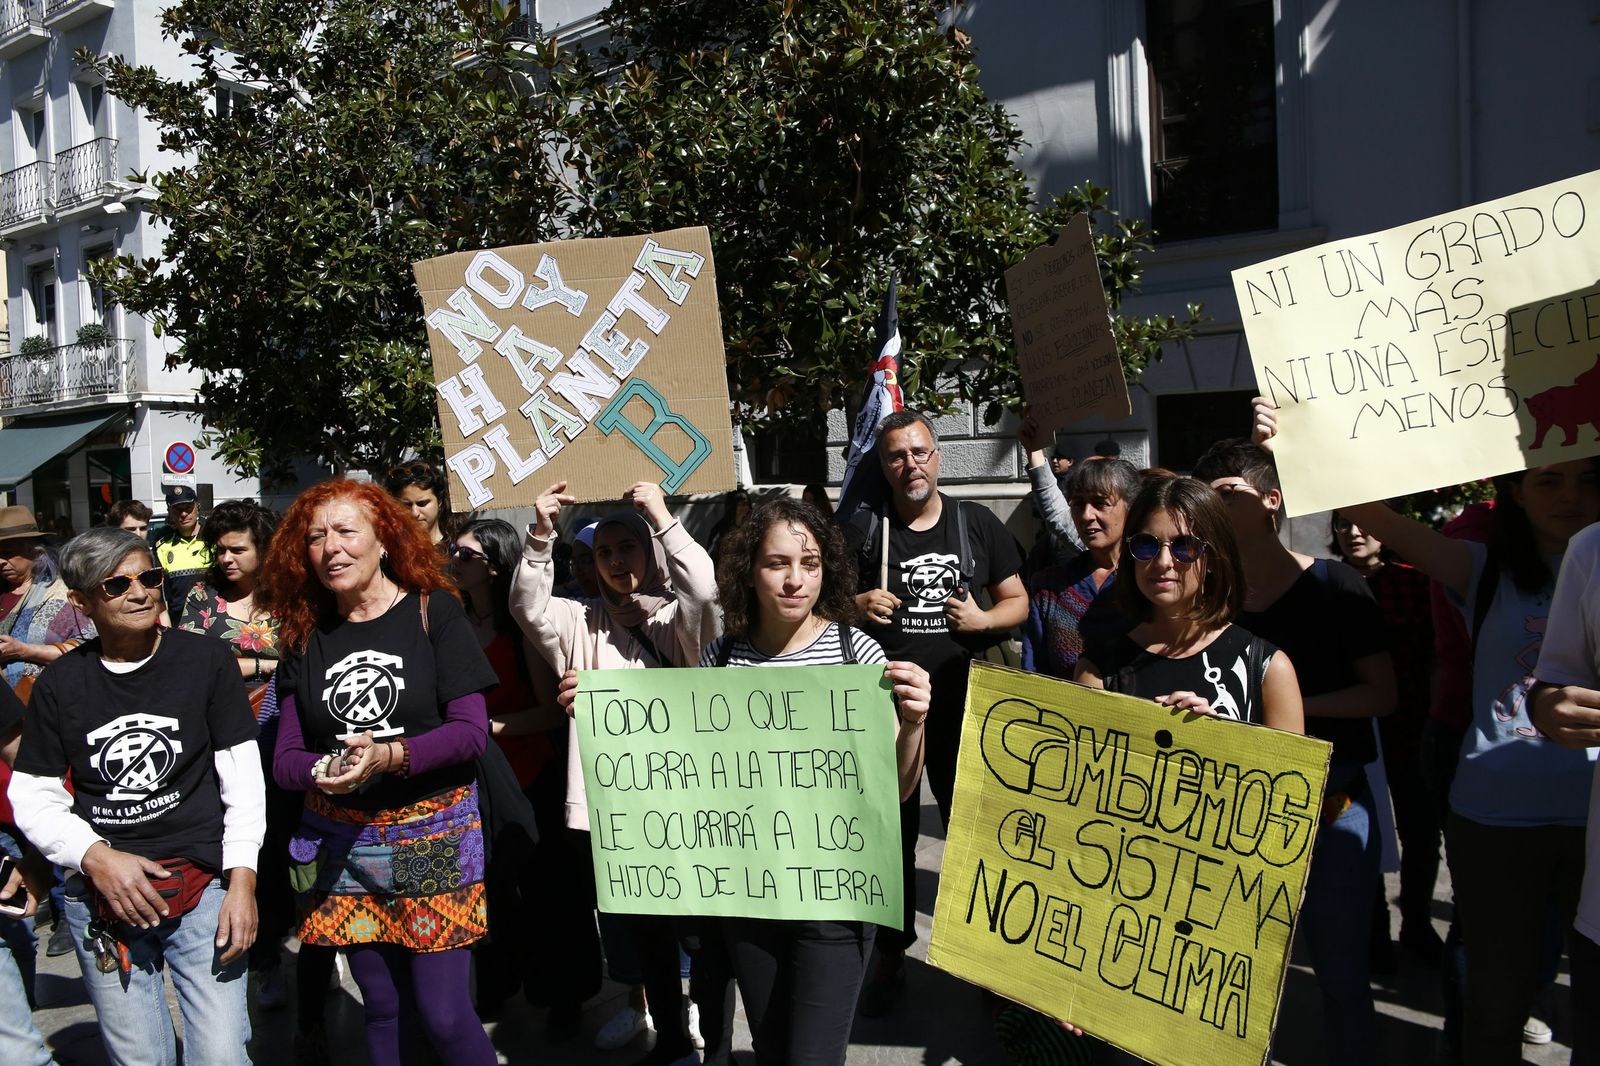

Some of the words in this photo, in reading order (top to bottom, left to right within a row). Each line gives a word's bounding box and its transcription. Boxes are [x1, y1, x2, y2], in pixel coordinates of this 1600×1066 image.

[1246, 266, 1297, 316] NI
[1318, 241, 1385, 298] UN
[1405, 191, 1586, 281] GRADO
[425, 250, 525, 365] NO
[1354, 277, 1484, 339] MÁS
[436, 252, 589, 438] HAY
[1022, 330, 1034, 349] NO
[1264, 356, 1317, 409] NI
[1326, 341, 1419, 396] UNA
[1433, 292, 1600, 376] ESPECIE
[445, 237, 706, 509] PLANETA
[594, 376, 713, 495] B
[1349, 376, 1519, 439] MENOS
[901, 618, 909, 626] DI
[911, 618, 922, 626] NO
[923, 618, 929, 627] A
[930, 618, 942, 627] LAS
[577, 689, 670, 737] TODO
[692, 691, 731, 733] LO
[747, 689, 808, 731] QUE
[831, 689, 866, 732] LE
[595, 751, 700, 791] OCURRA
[712, 751, 727, 789] A
[736, 751, 763, 789] LA
[768, 748, 864, 794] TIERRA,
[124, 804, 143, 817] LAS
[144, 790, 181, 811] TORRES
[596, 808, 634, 851] LE
[643, 805, 757, 851] OCURRIRÁ
[774, 810, 795, 850] A
[816, 813, 865, 852] LOS
[607, 861, 681, 899] HIJOS
[692, 864, 735, 898] DE
[745, 867, 778, 899] LA
[786, 866, 888, 907] TIERRA.
